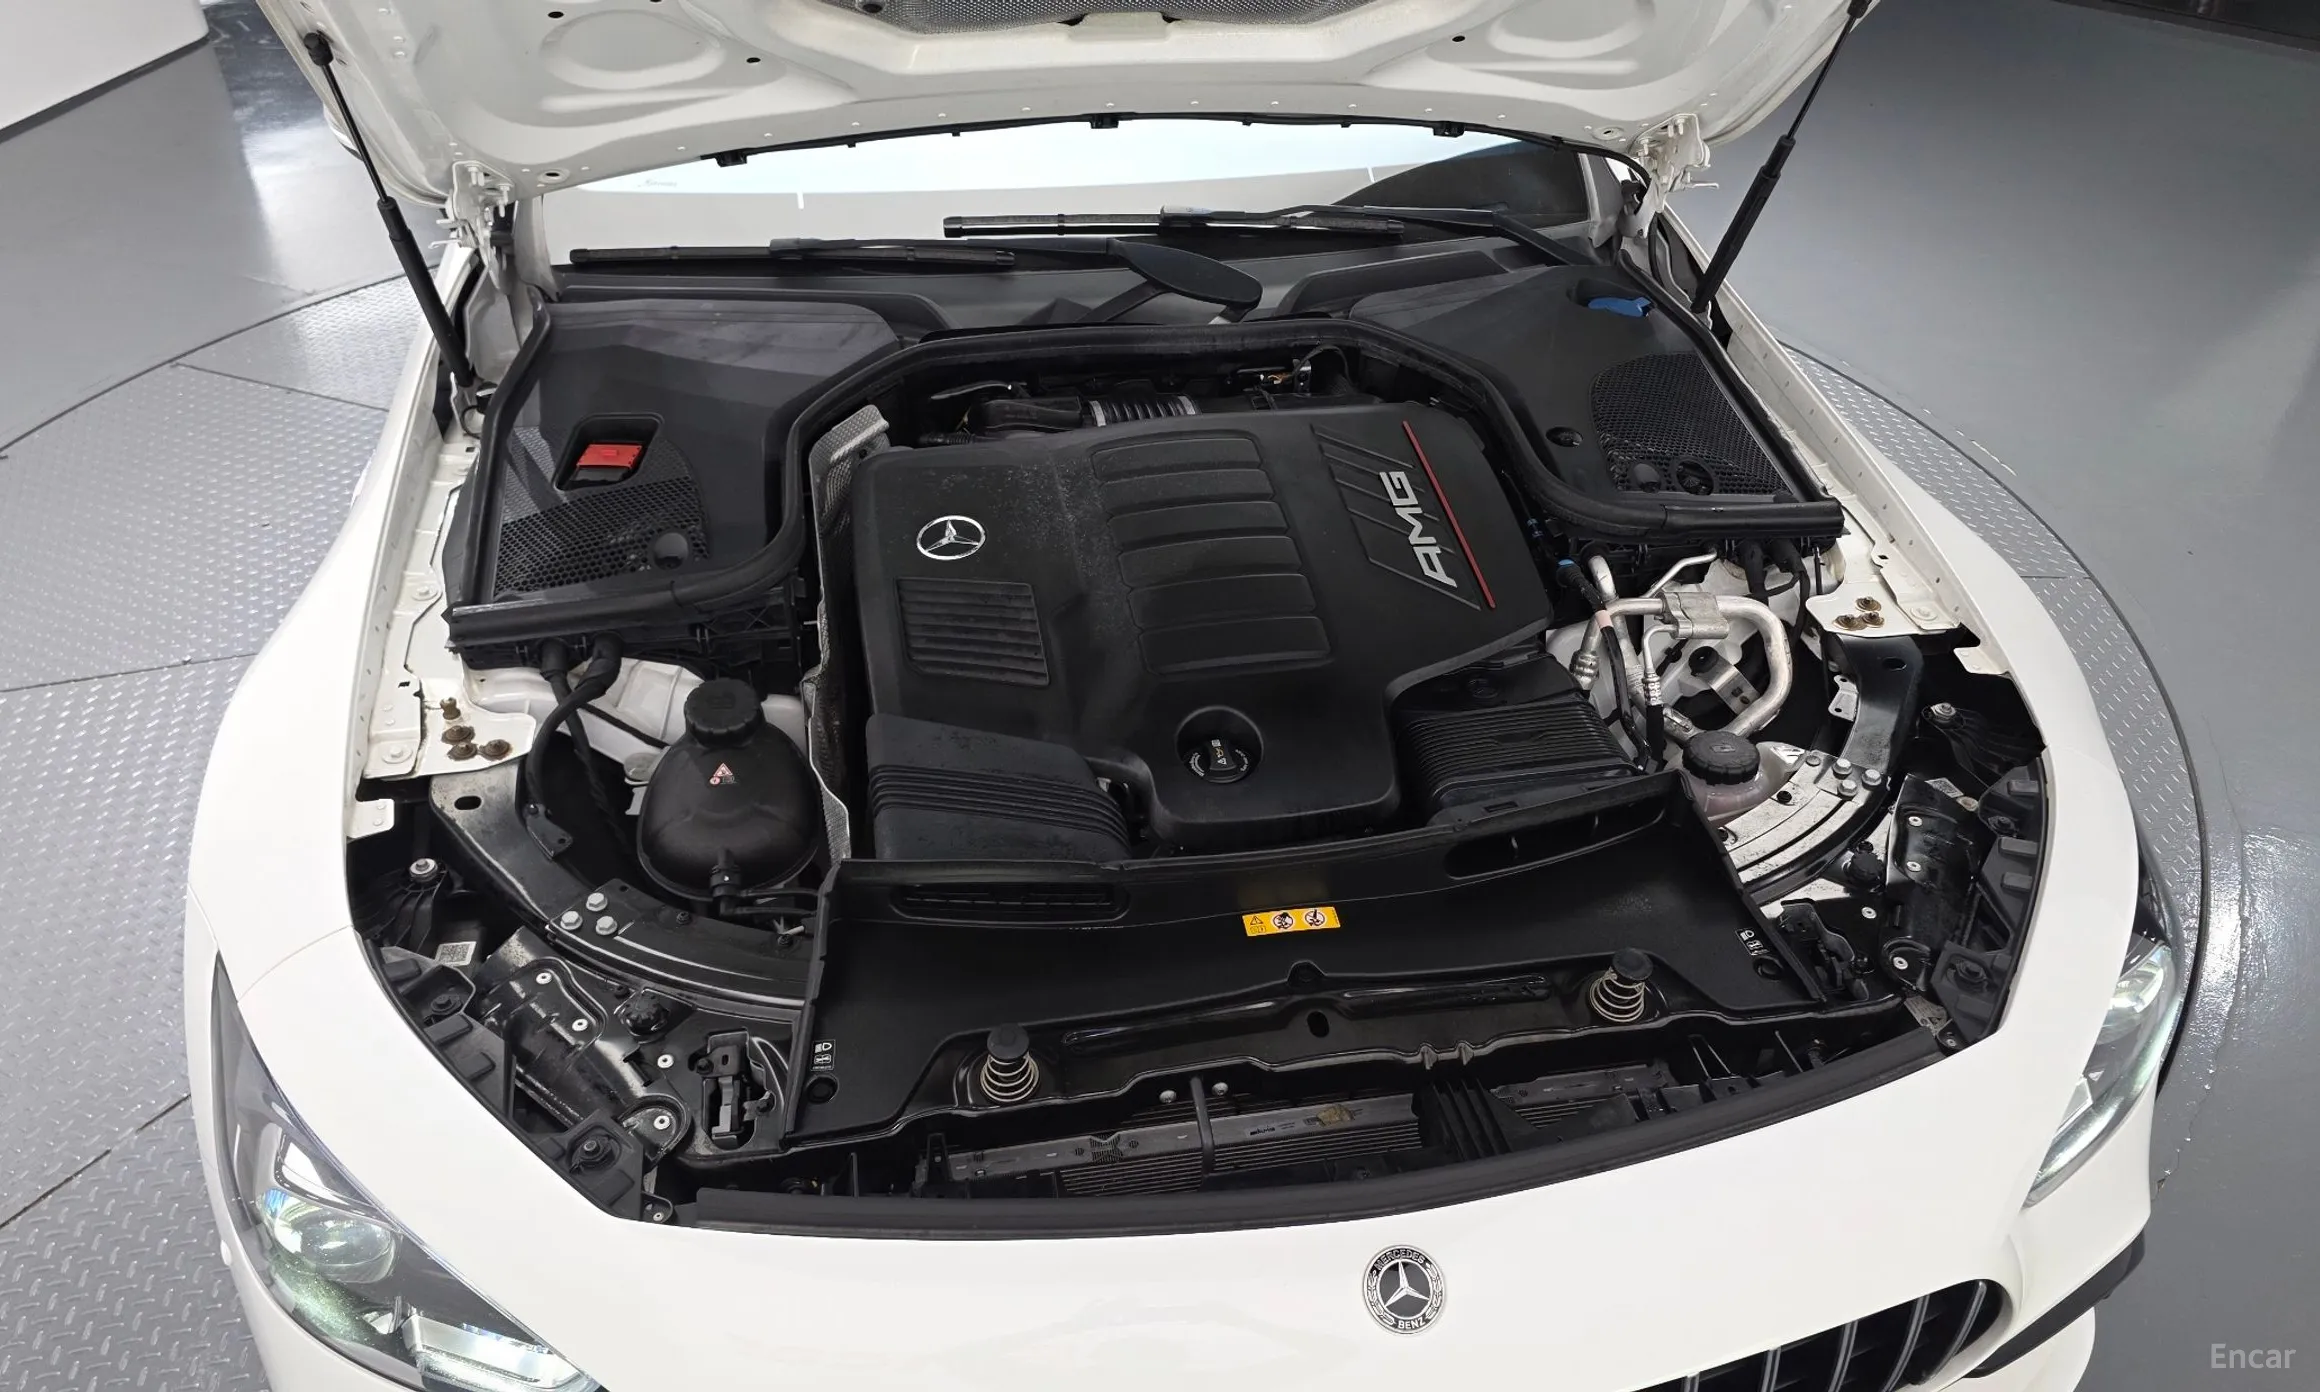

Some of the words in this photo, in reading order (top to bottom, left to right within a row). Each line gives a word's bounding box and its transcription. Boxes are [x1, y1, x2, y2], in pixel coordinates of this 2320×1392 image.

[1379, 471, 1458, 589] AMG
[1373, 1249, 1425, 1271] MERCEDES
[1398, 1316, 1427, 1330] BENZ
